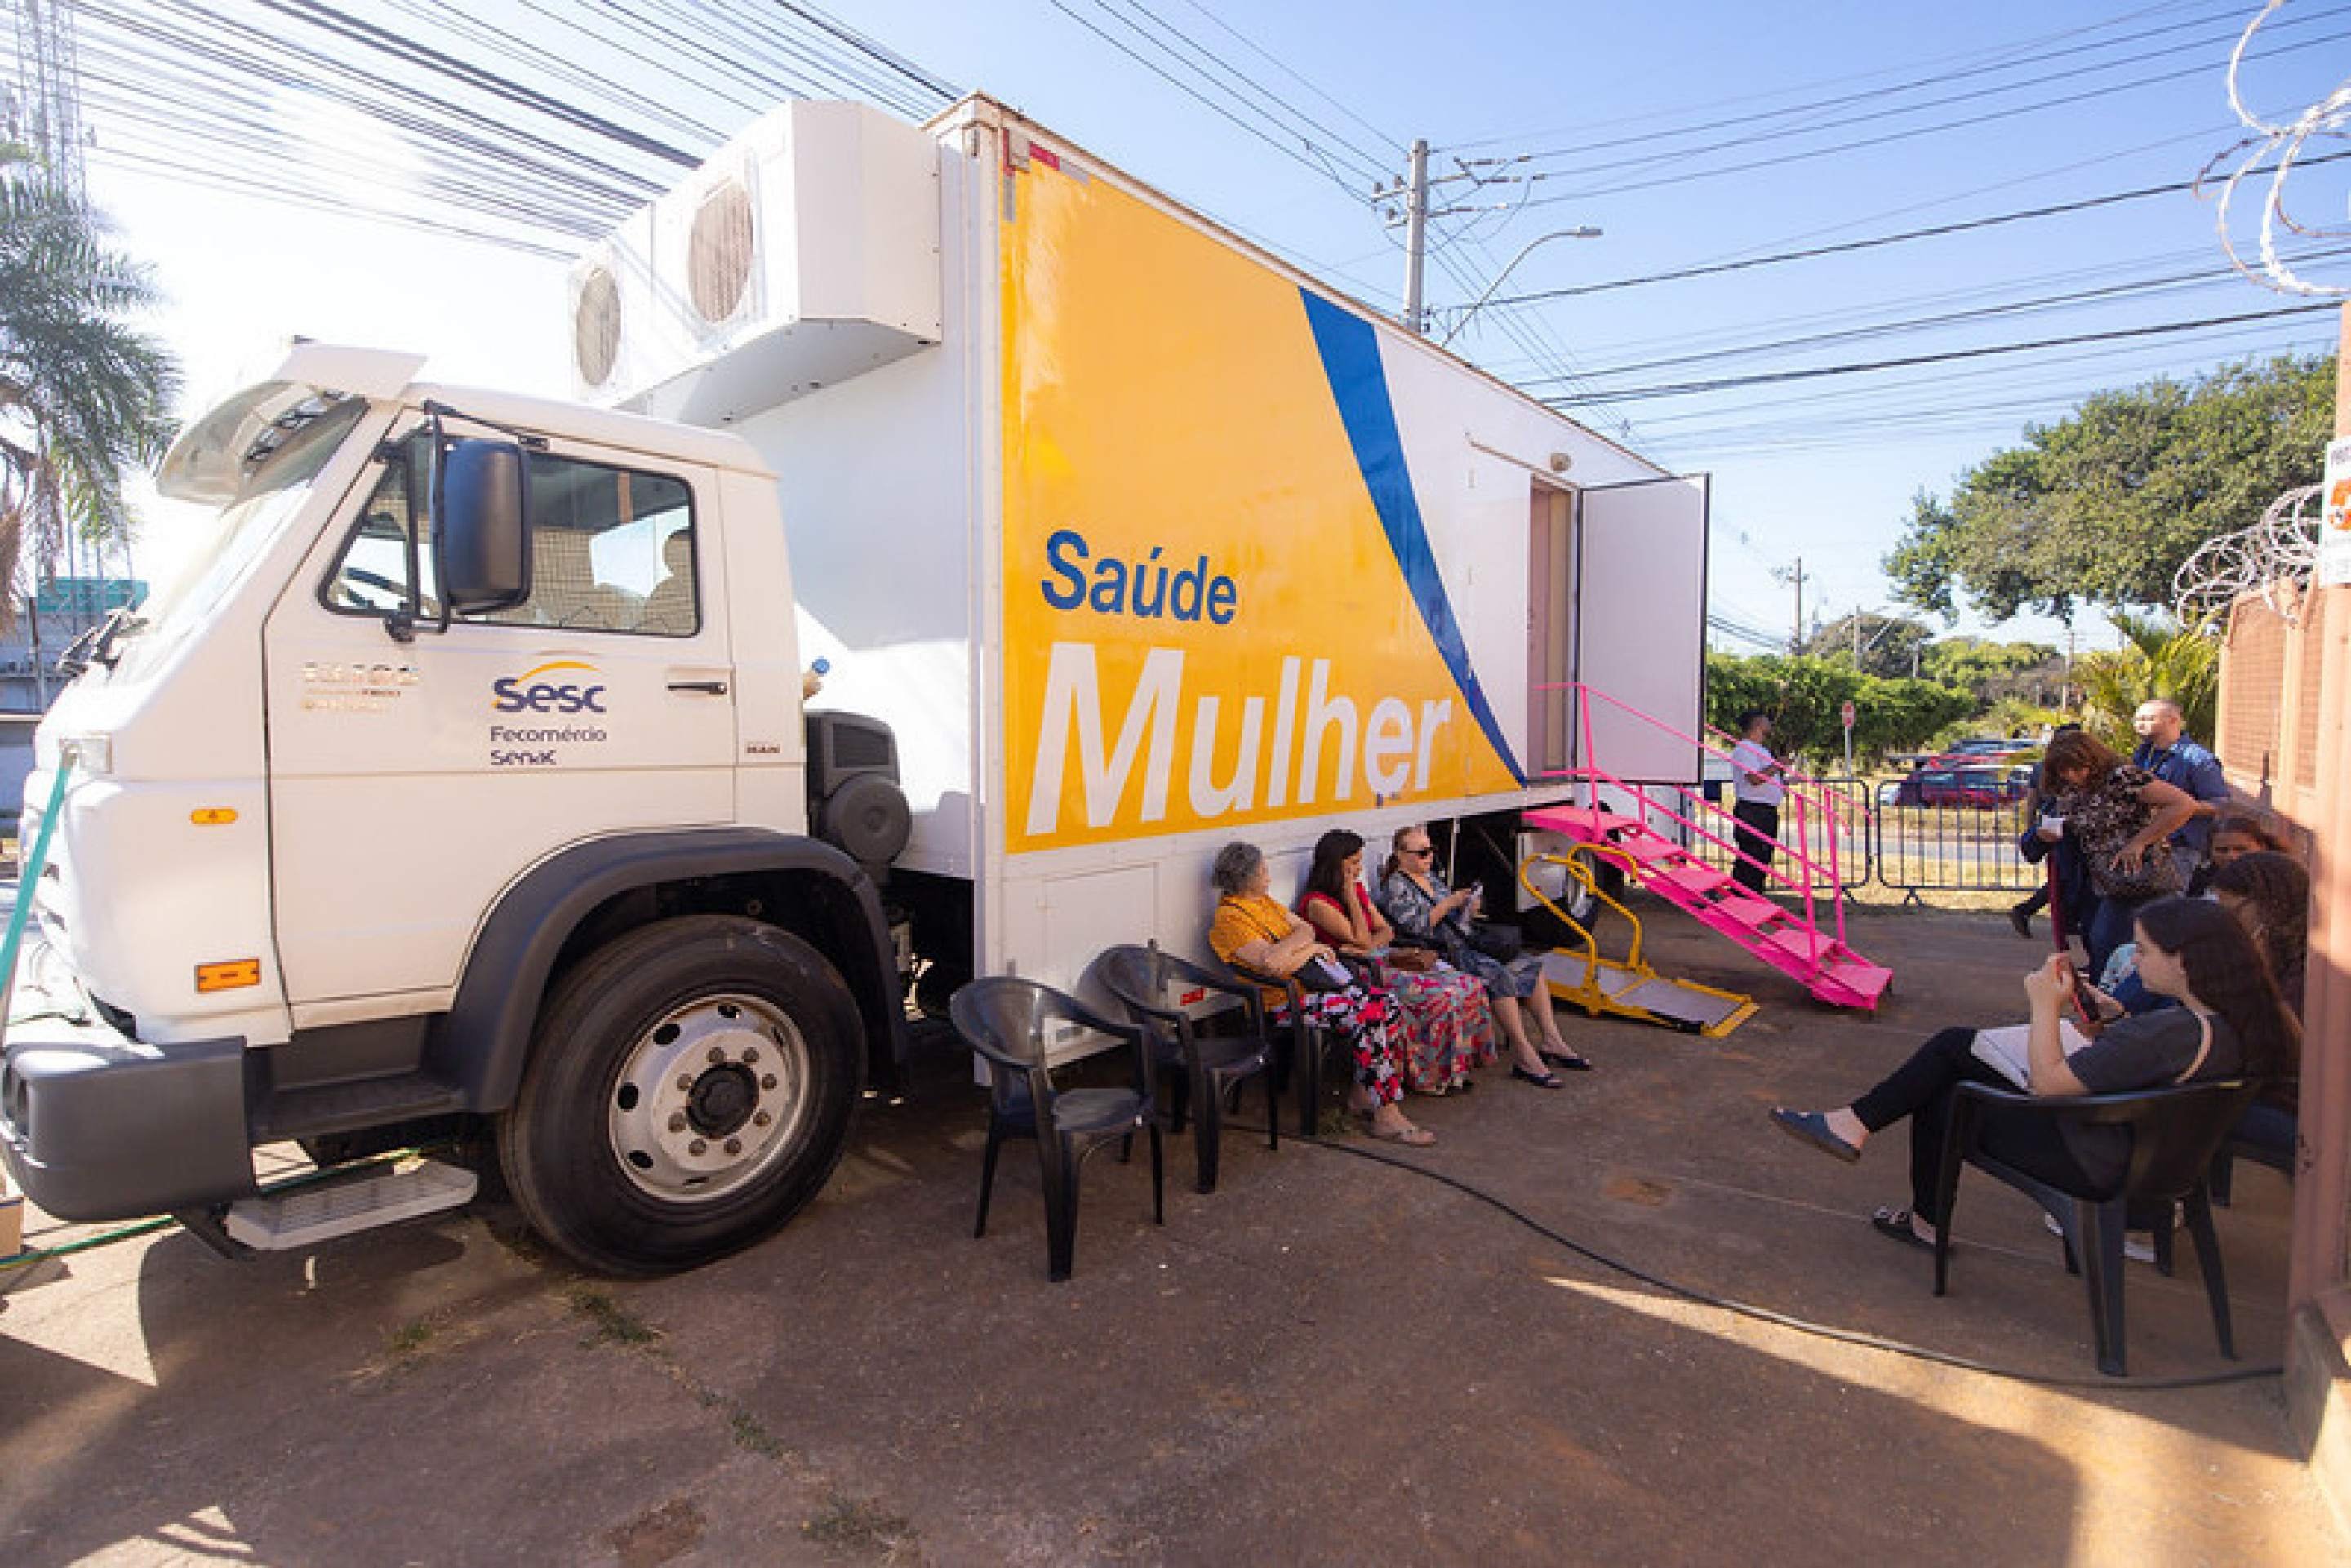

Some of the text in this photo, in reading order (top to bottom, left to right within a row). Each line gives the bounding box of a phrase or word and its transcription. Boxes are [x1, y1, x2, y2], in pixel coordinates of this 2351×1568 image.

[1041, 529, 1237, 624] Saúde
[492, 676, 607, 713] Sesc
[491, 723, 607, 742] Fecomércio
[1026, 641, 1451, 837] Mulher
[491, 748, 557, 766] Senac
